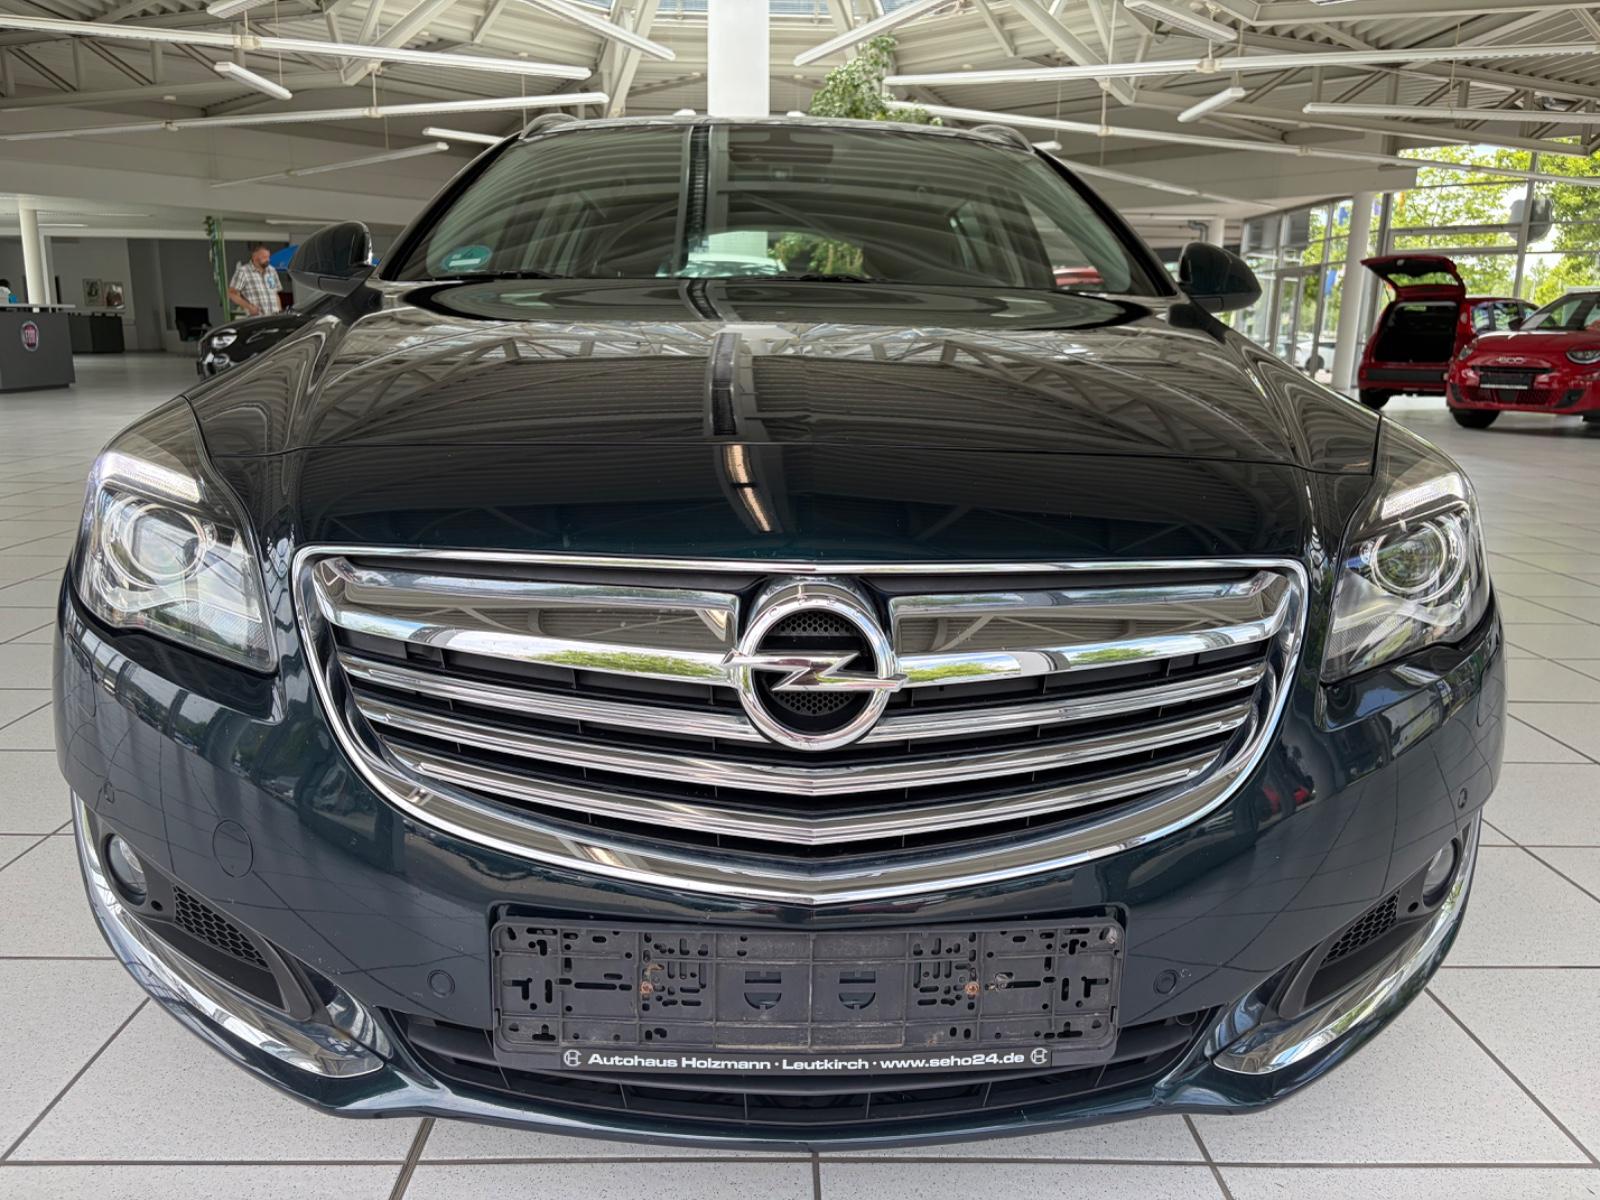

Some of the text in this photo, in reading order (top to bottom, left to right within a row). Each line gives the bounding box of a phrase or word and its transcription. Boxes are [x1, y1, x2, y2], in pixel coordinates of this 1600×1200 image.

[587, 1052, 1025, 1070] Autohaus Holzmann Leutkirch www.seho24.de
